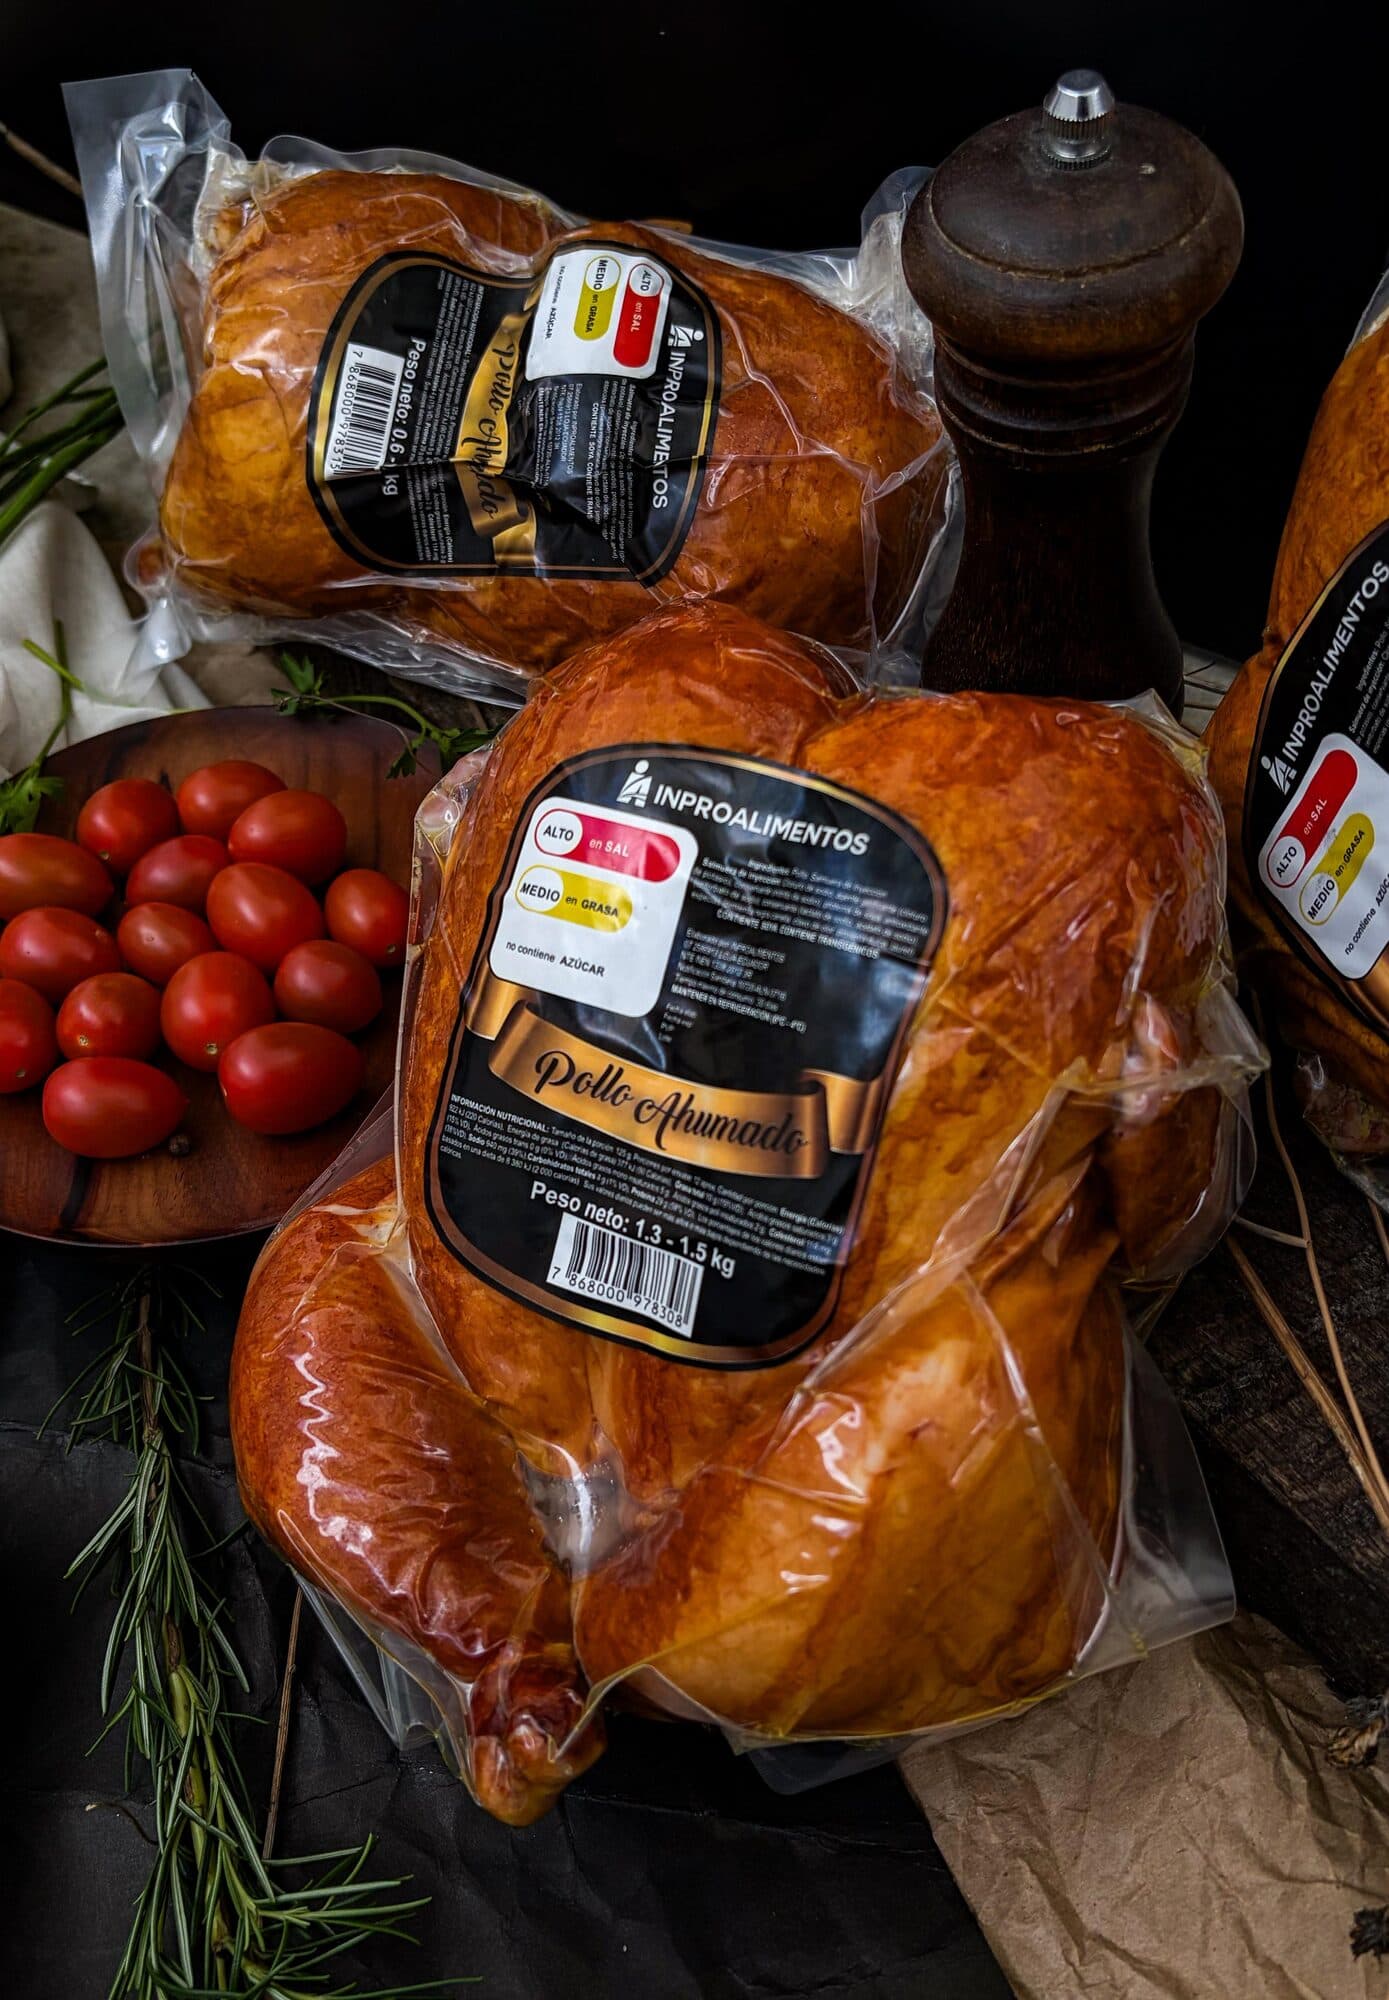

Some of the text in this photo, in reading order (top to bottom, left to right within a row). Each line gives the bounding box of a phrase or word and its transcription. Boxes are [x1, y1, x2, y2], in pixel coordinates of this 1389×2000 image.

[585, 258, 608, 333] MEDIO en GRASA
[630, 270, 651, 332] ALTO en SAL
[403, 337, 426, 380] Peso
[490, 342, 518, 416] Pollo
[329, 350, 362, 470] 7 868000 978315
[394, 382, 415, 424] neto:
[648, 350, 685, 509] INPROALIMETOS
[389, 427, 407, 454] 0.6
[380, 473, 401, 496] kg
[1282, 560, 1389, 764] INPROALIMENTOS
[542, 824, 630, 857] ALTO en SAL
[654, 783, 871, 856] INPROALIMENTOS
[1276, 798, 1328, 878] ALTO en SAL
[519, 882, 619, 917] MEDIO en GRASA
[1307, 829, 1365, 920] MEDIO en GRASA
[505, 941, 606, 976] no contiene AZÚCAR
[1345, 942, 1354, 956] no
[1352, 908, 1377, 945] contiene
[450, 1094, 496, 1115] INFORMACIÓN
[496, 1110, 549, 1133] NUTRICIONAL:
[534, 1050, 808, 1155] Pollo Ahumado
[468, 1134, 485, 1145] Sodio
[527, 1154, 573, 1174] Carbohidratos
[528, 1180, 583, 1213] Peso
[582, 1200, 631, 1232] neto:
[632, 1217, 665, 1244] 1.3
[676, 1234, 710, 1262] 1.5
[707, 1247, 739, 1279] kg
[550, 1266, 686, 1328] 7 868000 978308
